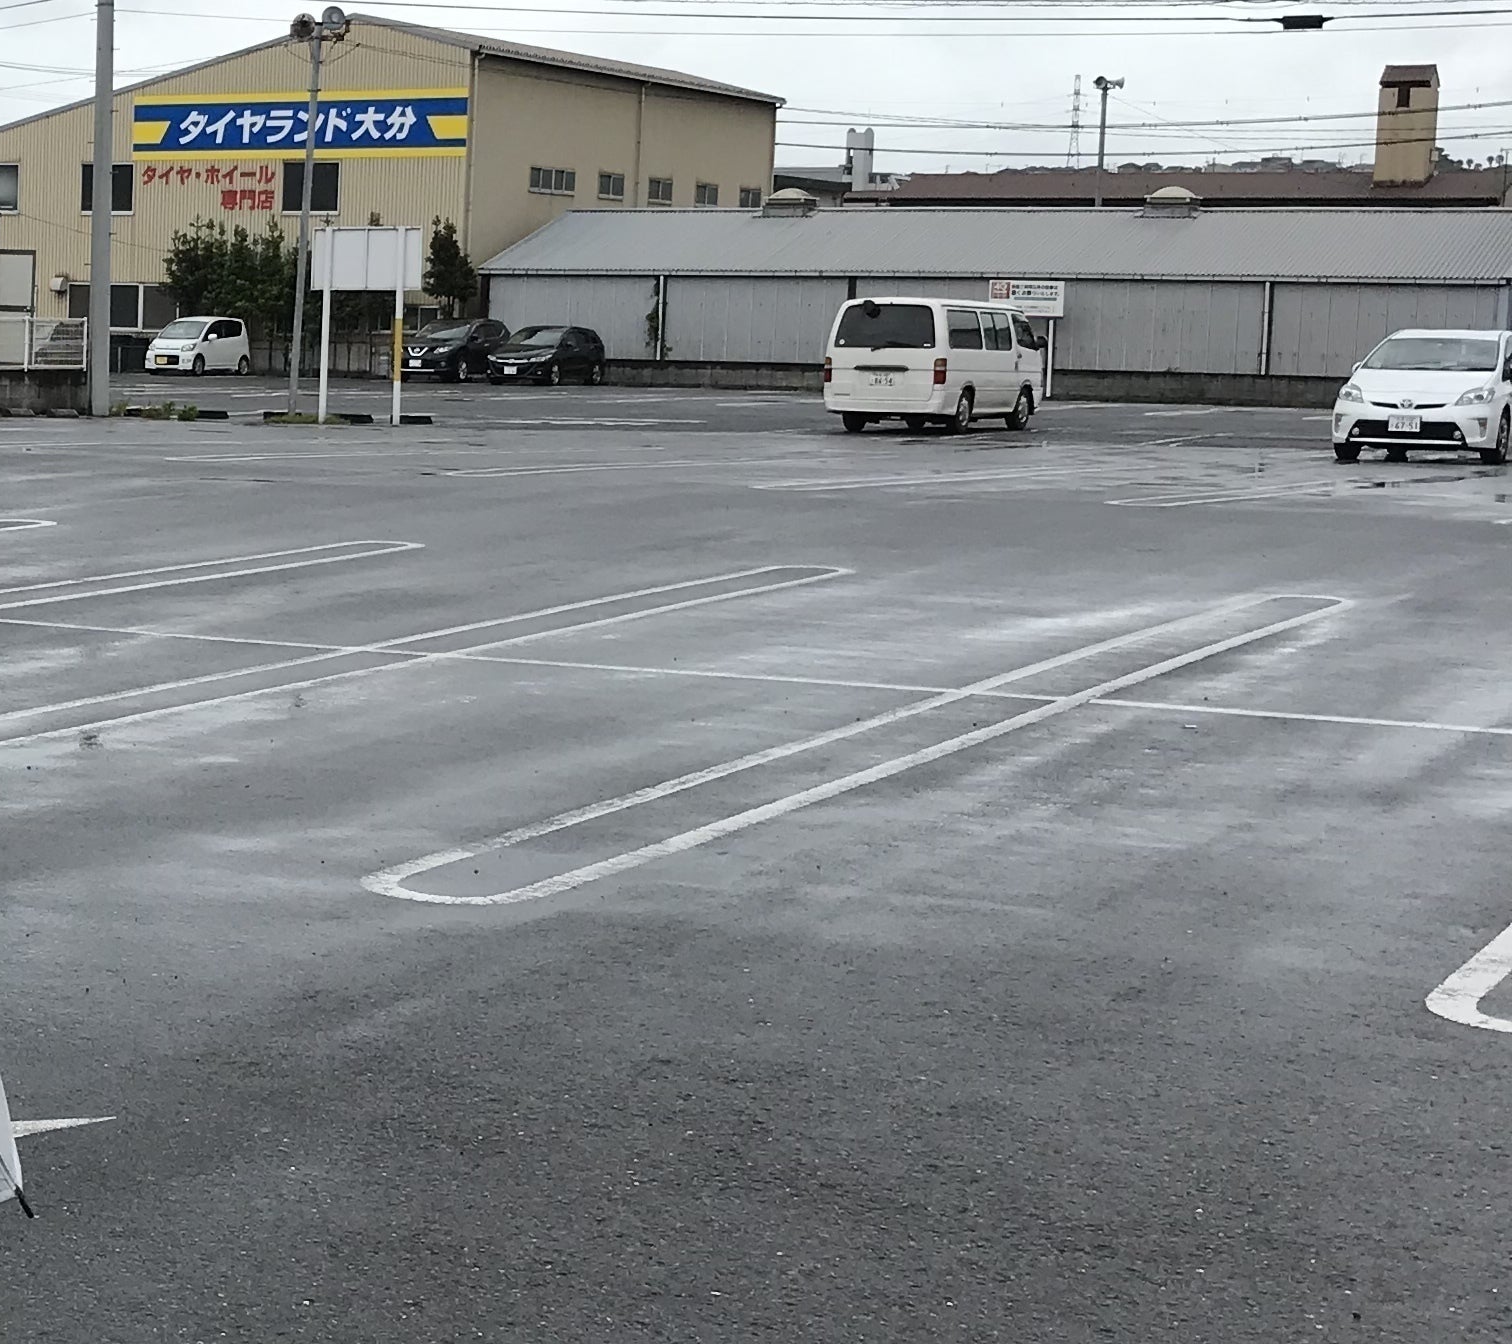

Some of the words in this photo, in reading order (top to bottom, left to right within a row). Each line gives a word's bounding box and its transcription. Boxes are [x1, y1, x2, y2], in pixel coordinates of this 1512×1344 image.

[179, 105, 417, 145] タイヤランド大分
[141, 165, 276, 186] タイヤ・ホイール
[220, 189, 275, 211] 専門店
